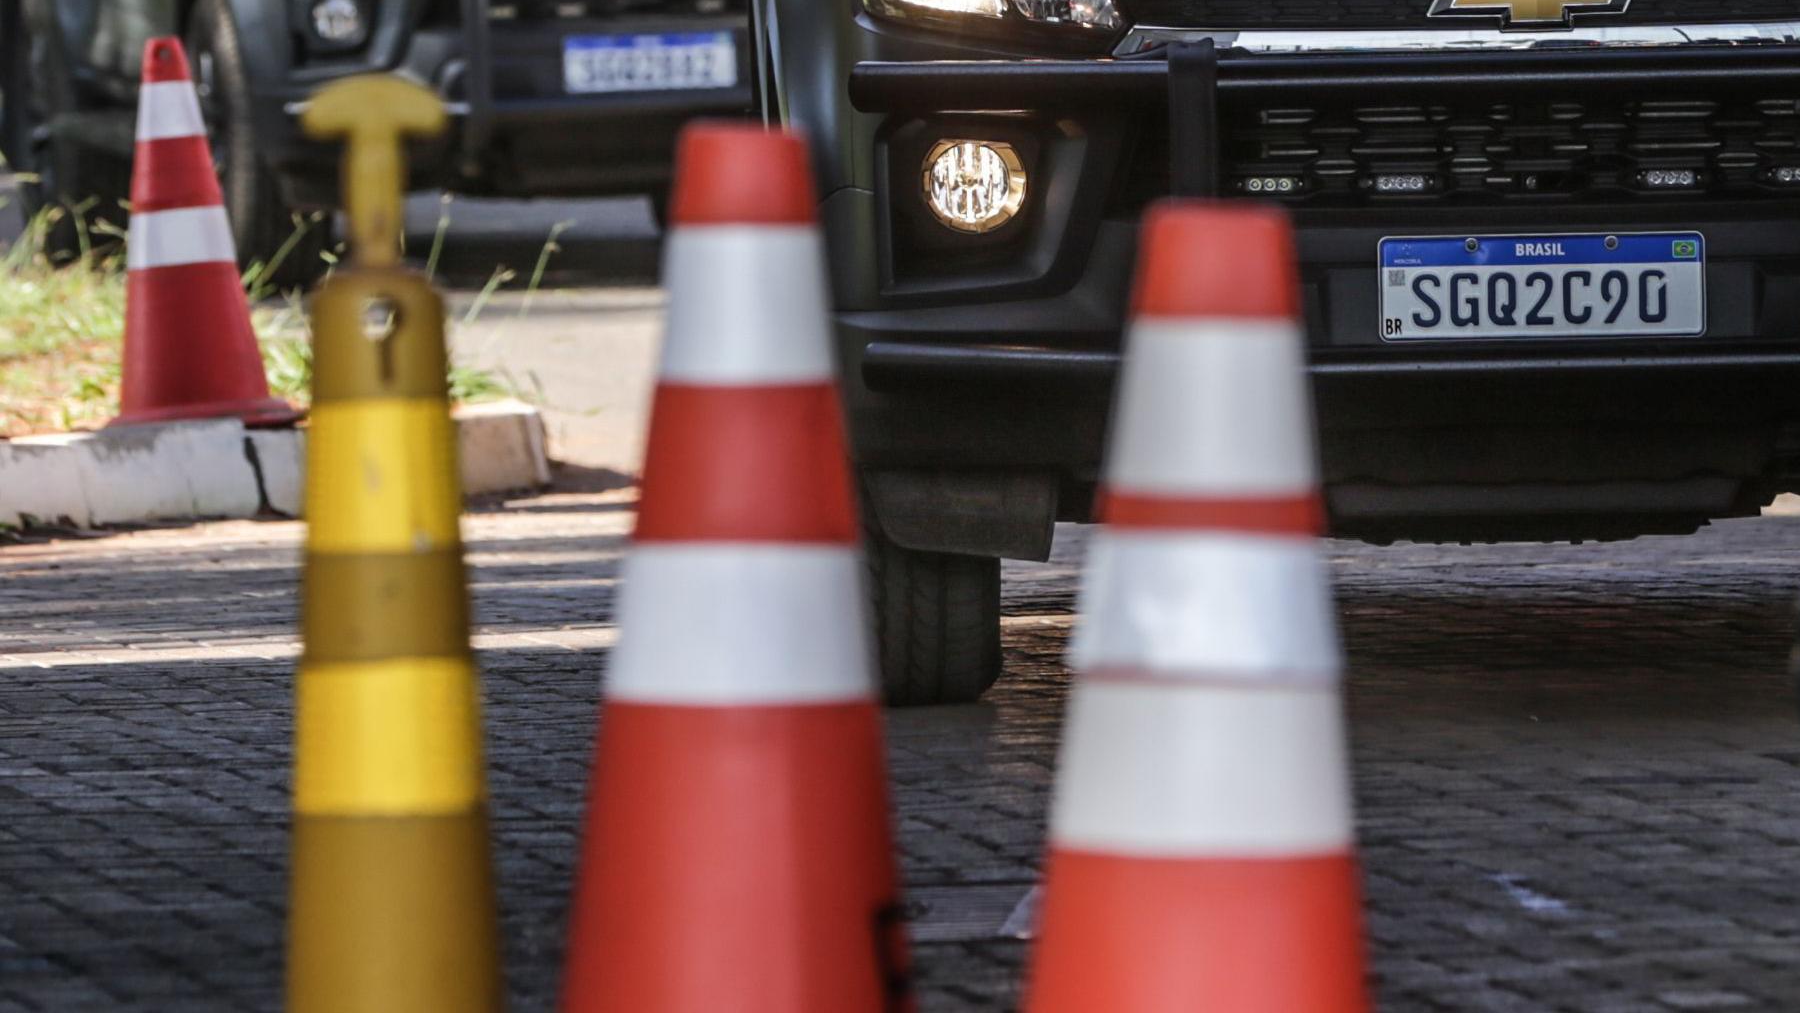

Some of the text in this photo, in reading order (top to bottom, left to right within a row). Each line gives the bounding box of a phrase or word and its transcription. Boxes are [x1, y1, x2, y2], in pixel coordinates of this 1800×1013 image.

[1515, 243, 1565, 256] BRASIL
[1411, 269, 1668, 328] SGQ2C90
[1385, 319, 1402, 335] BR
